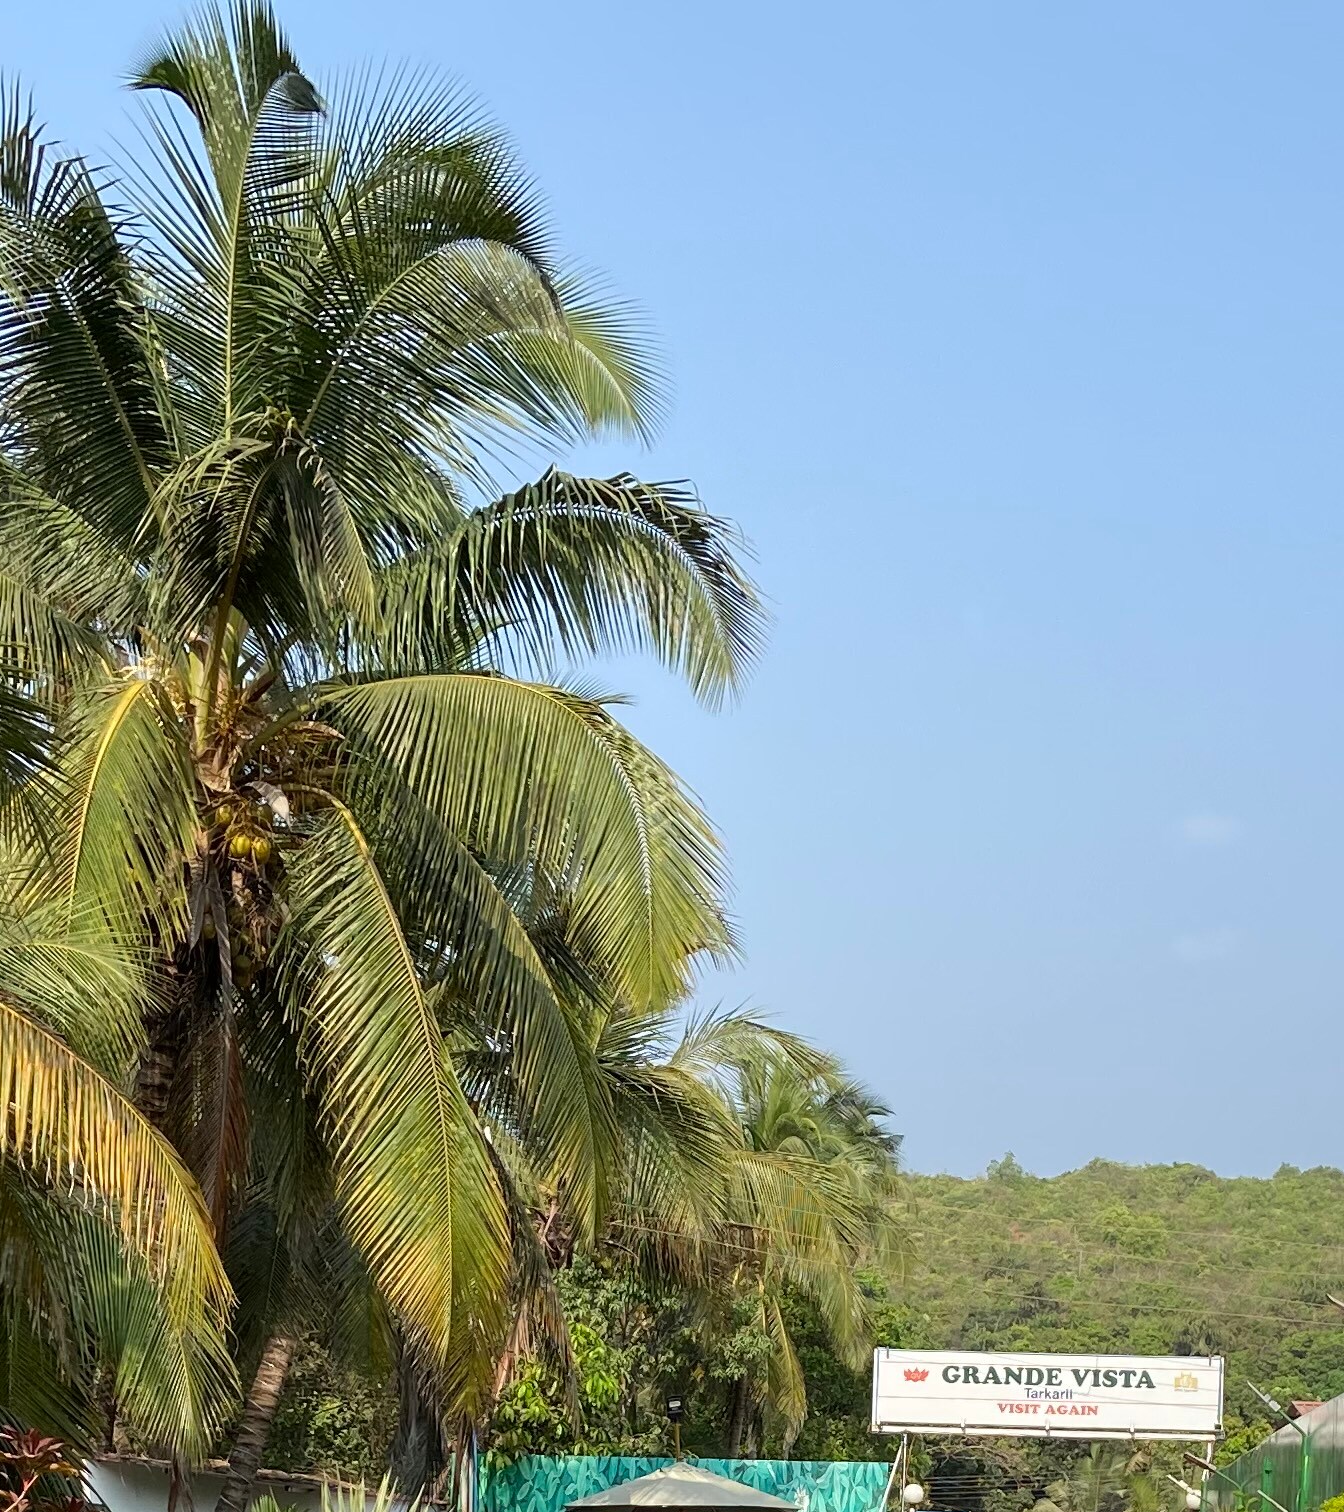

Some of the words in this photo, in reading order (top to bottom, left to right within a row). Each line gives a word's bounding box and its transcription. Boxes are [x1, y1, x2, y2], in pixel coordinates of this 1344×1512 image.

[941, 1365, 1063, 1387] GRANDE
[1071, 1368, 1156, 1389] VISTA
[997, 1403, 1041, 1415] VISIT
[1045, 1404, 1099, 1416] AGAIN
